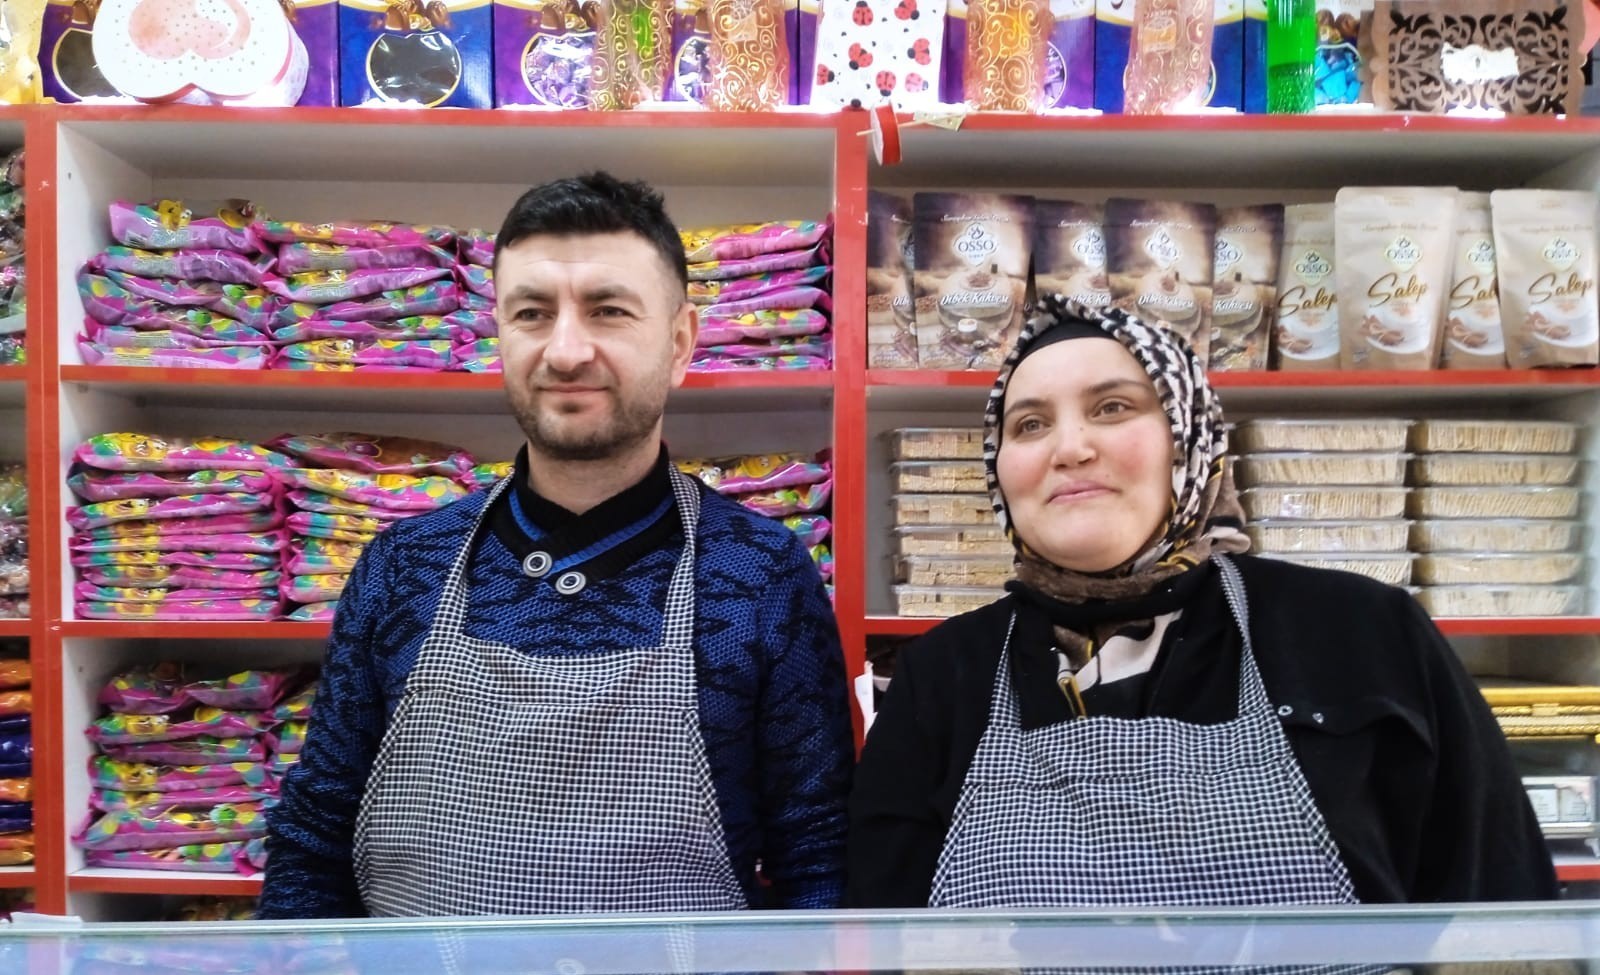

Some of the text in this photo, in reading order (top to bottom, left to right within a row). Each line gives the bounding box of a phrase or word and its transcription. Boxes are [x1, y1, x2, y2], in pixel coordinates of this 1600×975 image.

[958, 240, 994, 252] OSSO
[1150, 242, 1177, 258] OSSO
[1386, 249, 1420, 259] OSSO
[1544, 249, 1579, 259] OSSO
[1295, 263, 1329, 273] OSSO
[1367, 272, 1428, 308] Salep
[1528, 272, 1593, 305] Salep
[941, 291, 1009, 306] Dibek Kahvesi
[1138, 294, 1162, 305] Dibek
[1278, 286, 1337, 318] Salep
[1215, 299, 1253, 313] Kahvesi
